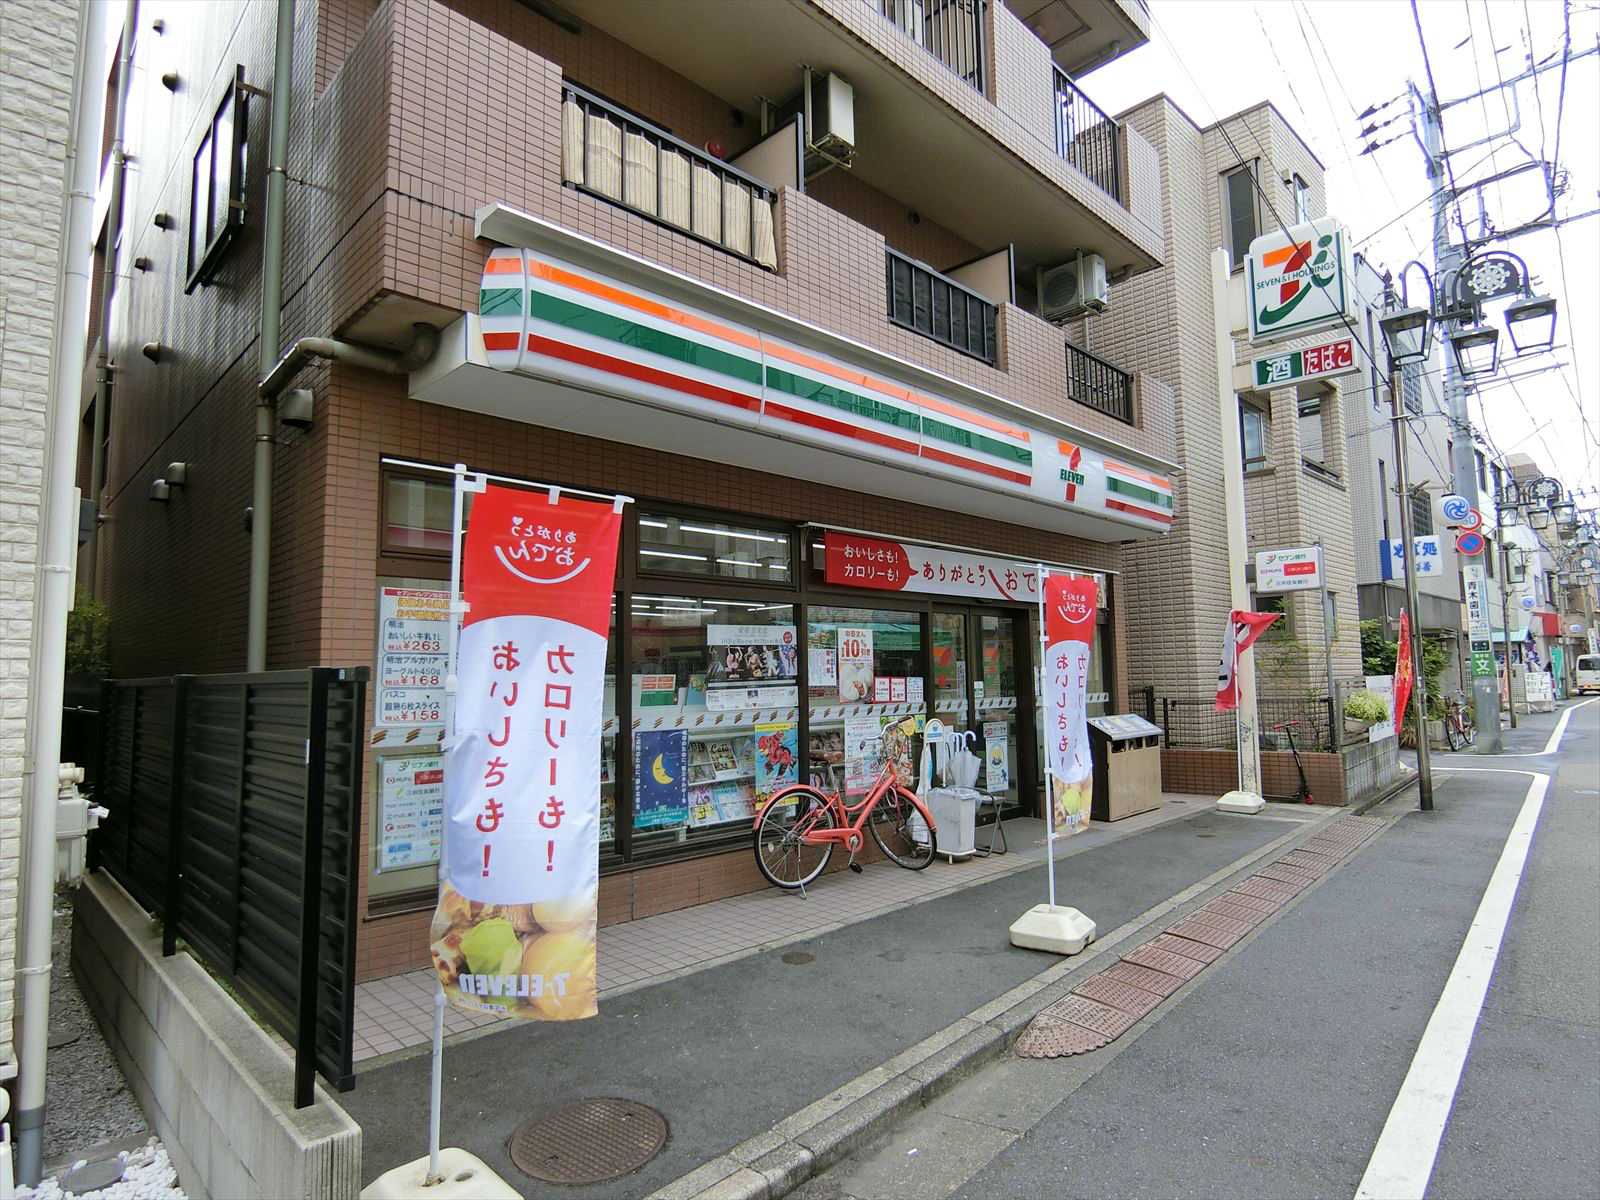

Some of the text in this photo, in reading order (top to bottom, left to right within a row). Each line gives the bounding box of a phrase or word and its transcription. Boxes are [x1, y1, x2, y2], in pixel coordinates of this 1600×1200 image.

[1293, 261, 1336, 279] HOLDINGS
[1305, 343, 1351, 375] たばこ
[1266, 356, 1292, 383] 酒
[844, 543, 899, 564] おいしさも!
[844, 563, 899, 582] カロリーも!
[923, 560, 986, 587] ありがとう
[1005, 568, 1037, 593] おで
[1468, 581, 1480, 619] 青木歯科
[388, 620, 404, 628] 明治
[388, 632, 442, 641] おいしい牛乳1L
[386, 655, 439, 665] 明治ブルガリア
[385, 667, 440, 675] ヨーグルト450g
[385, 690, 406, 698] パスコ
